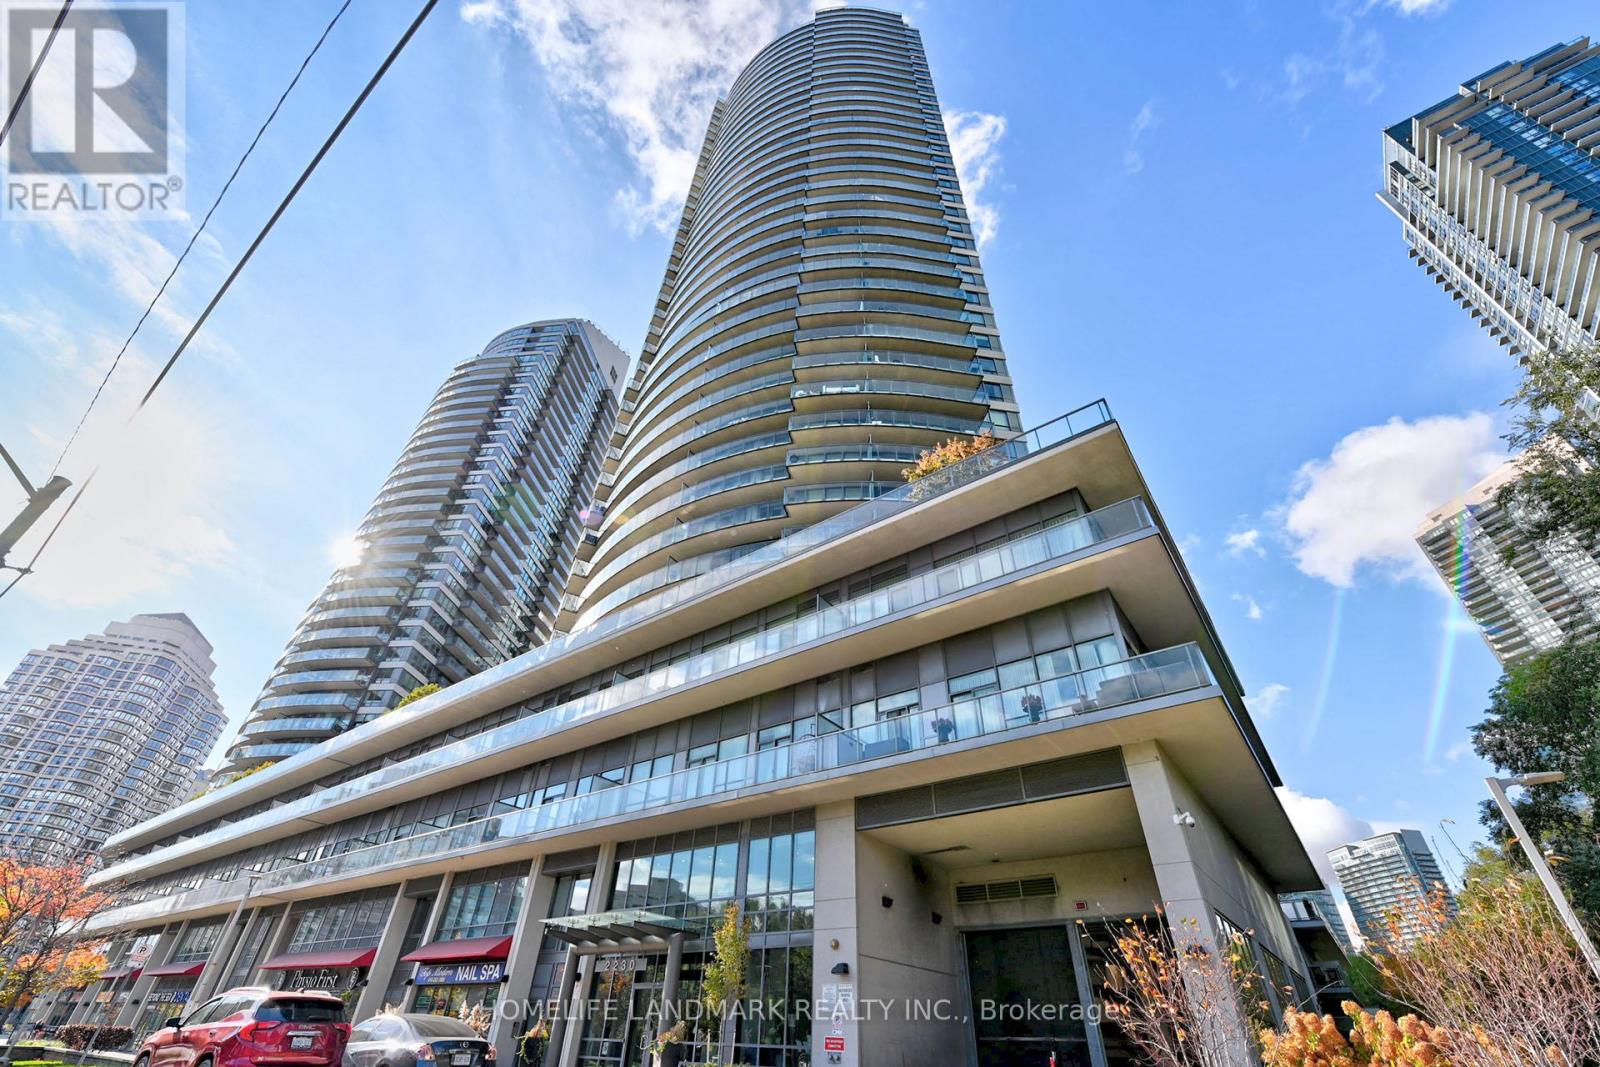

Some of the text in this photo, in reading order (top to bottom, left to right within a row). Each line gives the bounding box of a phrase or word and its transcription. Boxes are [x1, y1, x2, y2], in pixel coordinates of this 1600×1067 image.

[604, 959, 636, 971] 2230
[455, 965, 478, 981] NAIL
[480, 964, 501, 980] SPA
